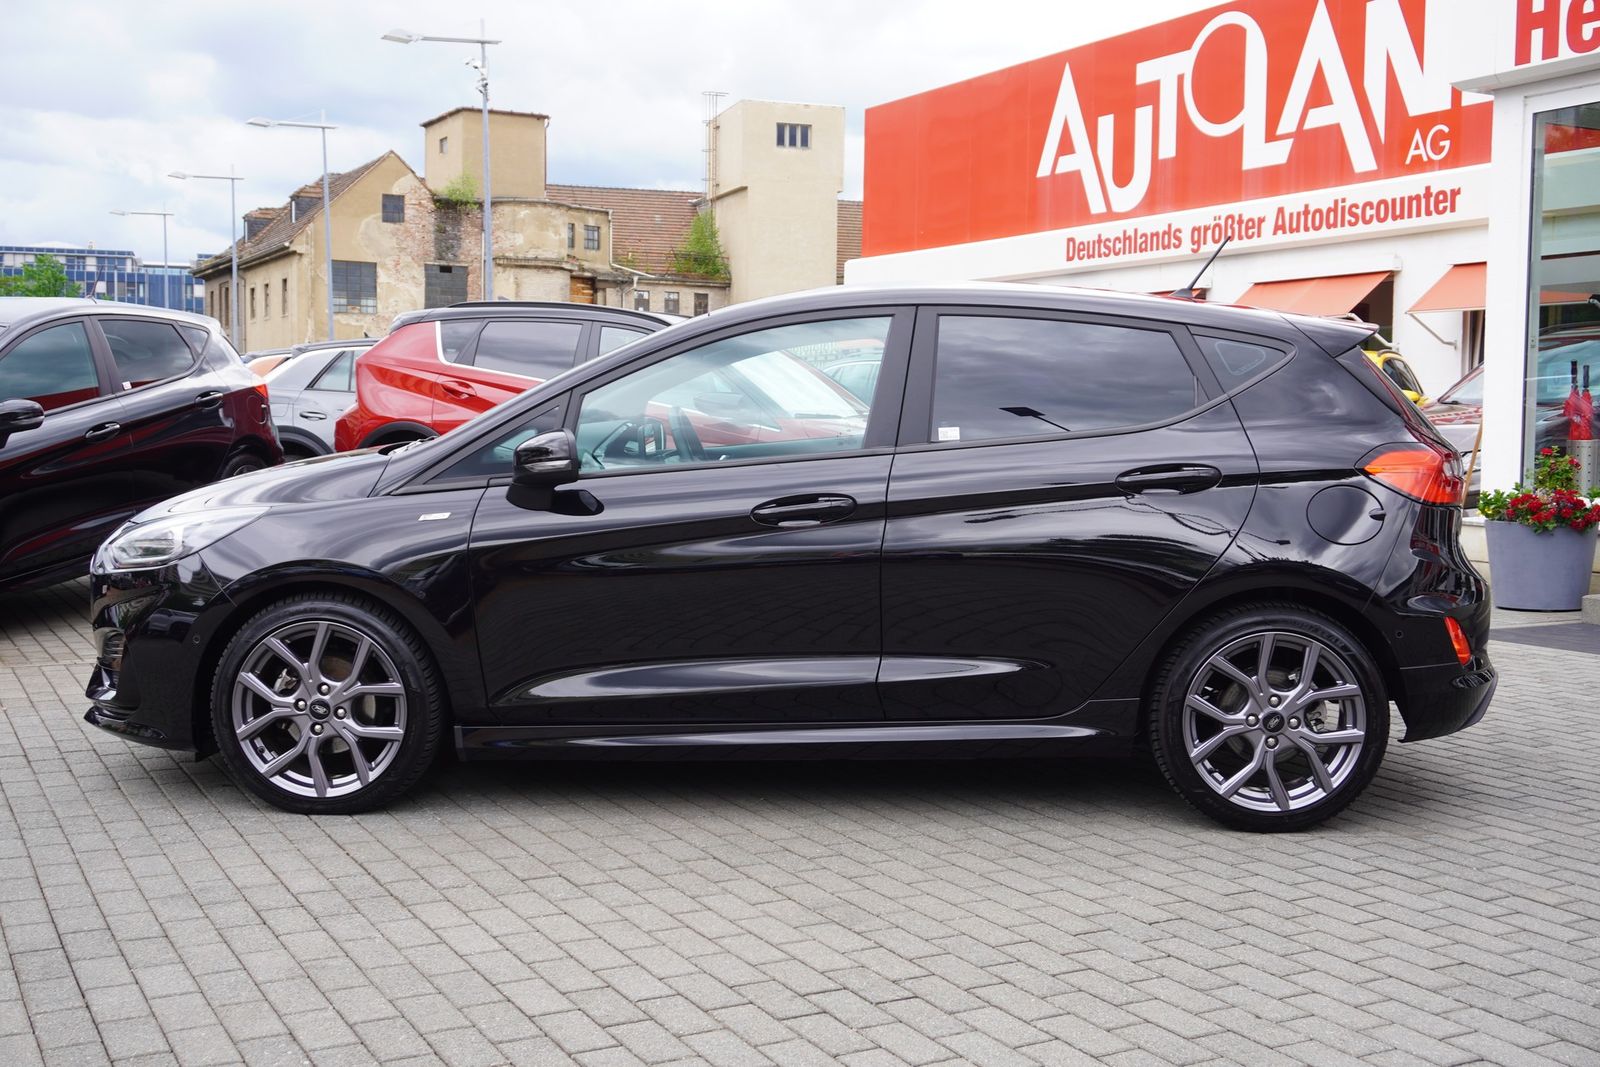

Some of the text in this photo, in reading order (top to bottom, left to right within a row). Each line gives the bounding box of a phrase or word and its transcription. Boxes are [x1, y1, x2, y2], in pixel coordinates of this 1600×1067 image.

[1036, 0, 1494, 214] AUTOLAN
[1405, 124, 1451, 165] AG
[1066, 185, 1462, 262] Deutschlands größter Autodiscounter
